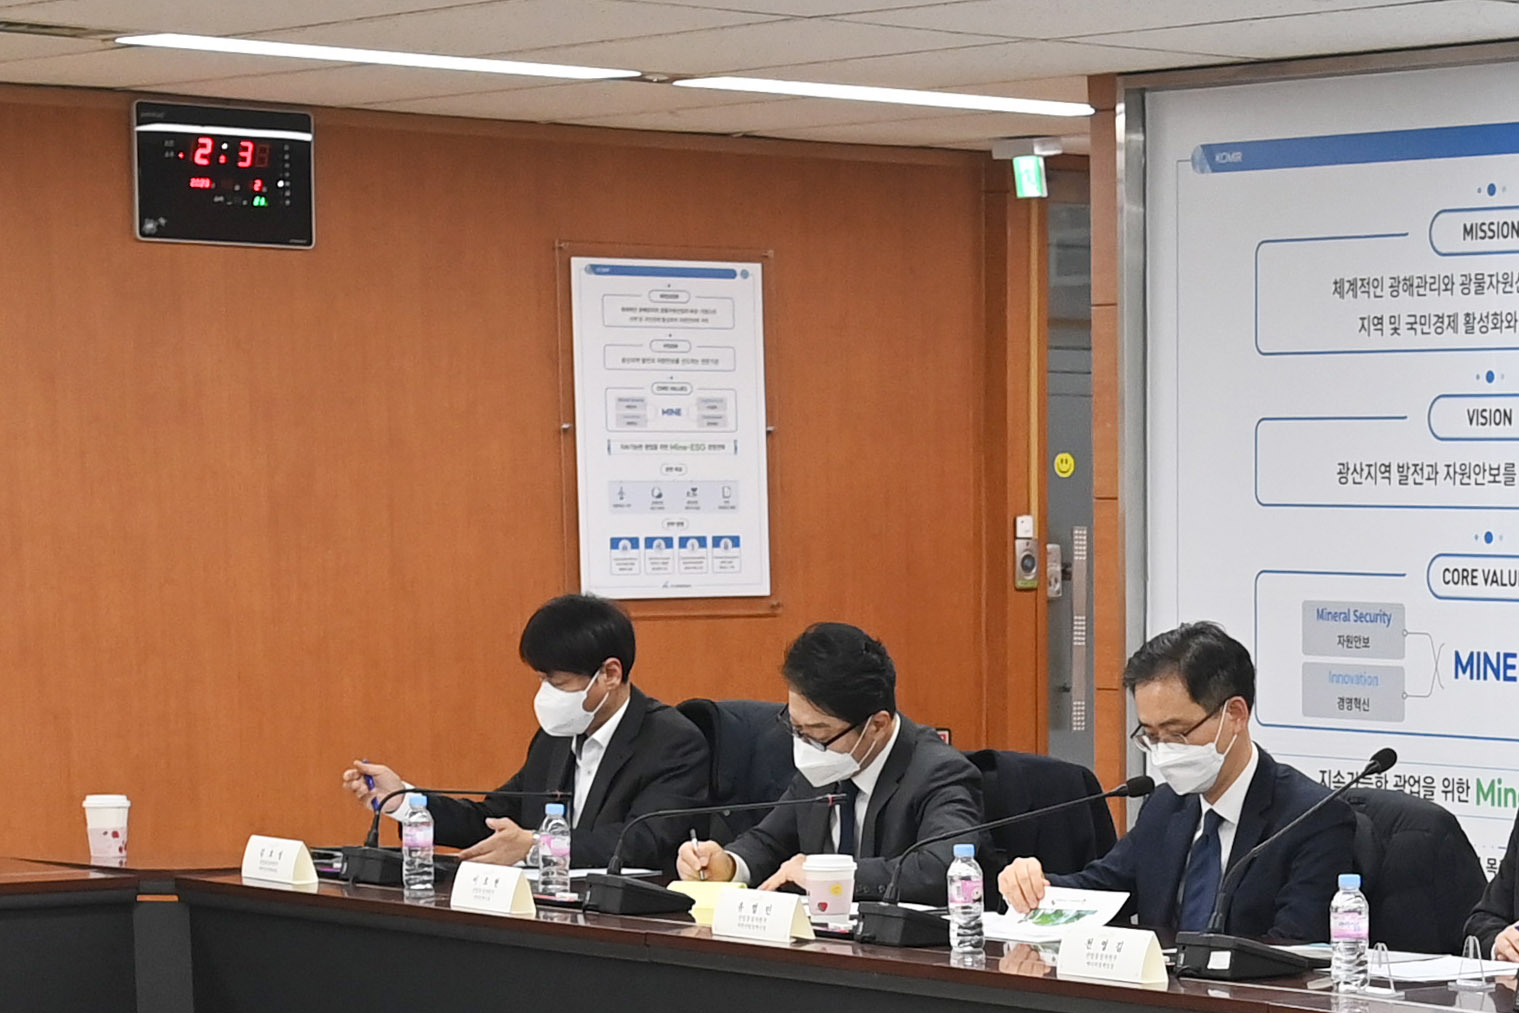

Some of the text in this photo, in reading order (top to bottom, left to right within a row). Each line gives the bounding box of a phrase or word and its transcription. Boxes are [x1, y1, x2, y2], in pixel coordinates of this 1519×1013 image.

[1463, 221, 1519, 240] MISSION
[1333, 276, 1383, 299] 체계적인
[1389, 274, 1455, 298] 광해관리와
[1359, 315, 1383, 336] 지역
[1389, 314, 1400, 336] 및
[1406, 313, 1458, 335] 국민경제
[1464, 311, 1518, 334] 활성화와
[1467, 409, 1512, 426] VISION
[1337, 462, 1391, 485] 광산지역
[1397, 462, 1439, 485] 발전과
[1444, 462, 1516, 486] 자원안보를
[1443, 568, 1478, 586] CORE
[1317, 608, 1391, 627] Mineral Security
[1337, 635, 1370, 649] 자원안보
[1455, 651, 1517, 682] MINE
[1329, 671, 1378, 686] Innovation
[1441, 778, 1470, 803] 위한
